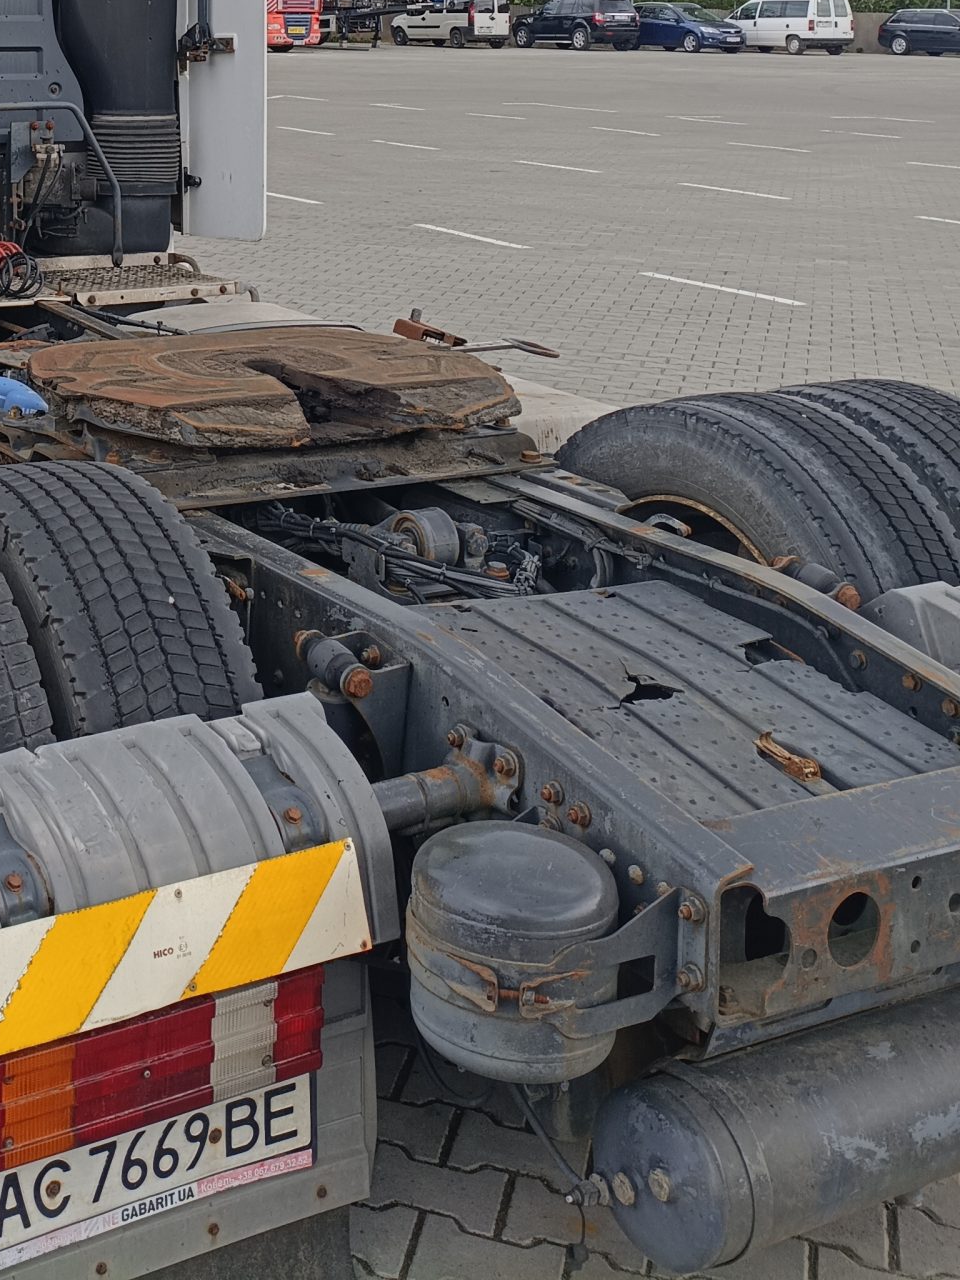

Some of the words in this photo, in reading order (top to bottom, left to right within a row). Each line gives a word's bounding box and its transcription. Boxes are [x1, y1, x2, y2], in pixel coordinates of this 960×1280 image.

[153, 947, 174, 959] HICO
[88, 1112, 210, 1204] 7669
[225, 1082, 298, 1158] BE
